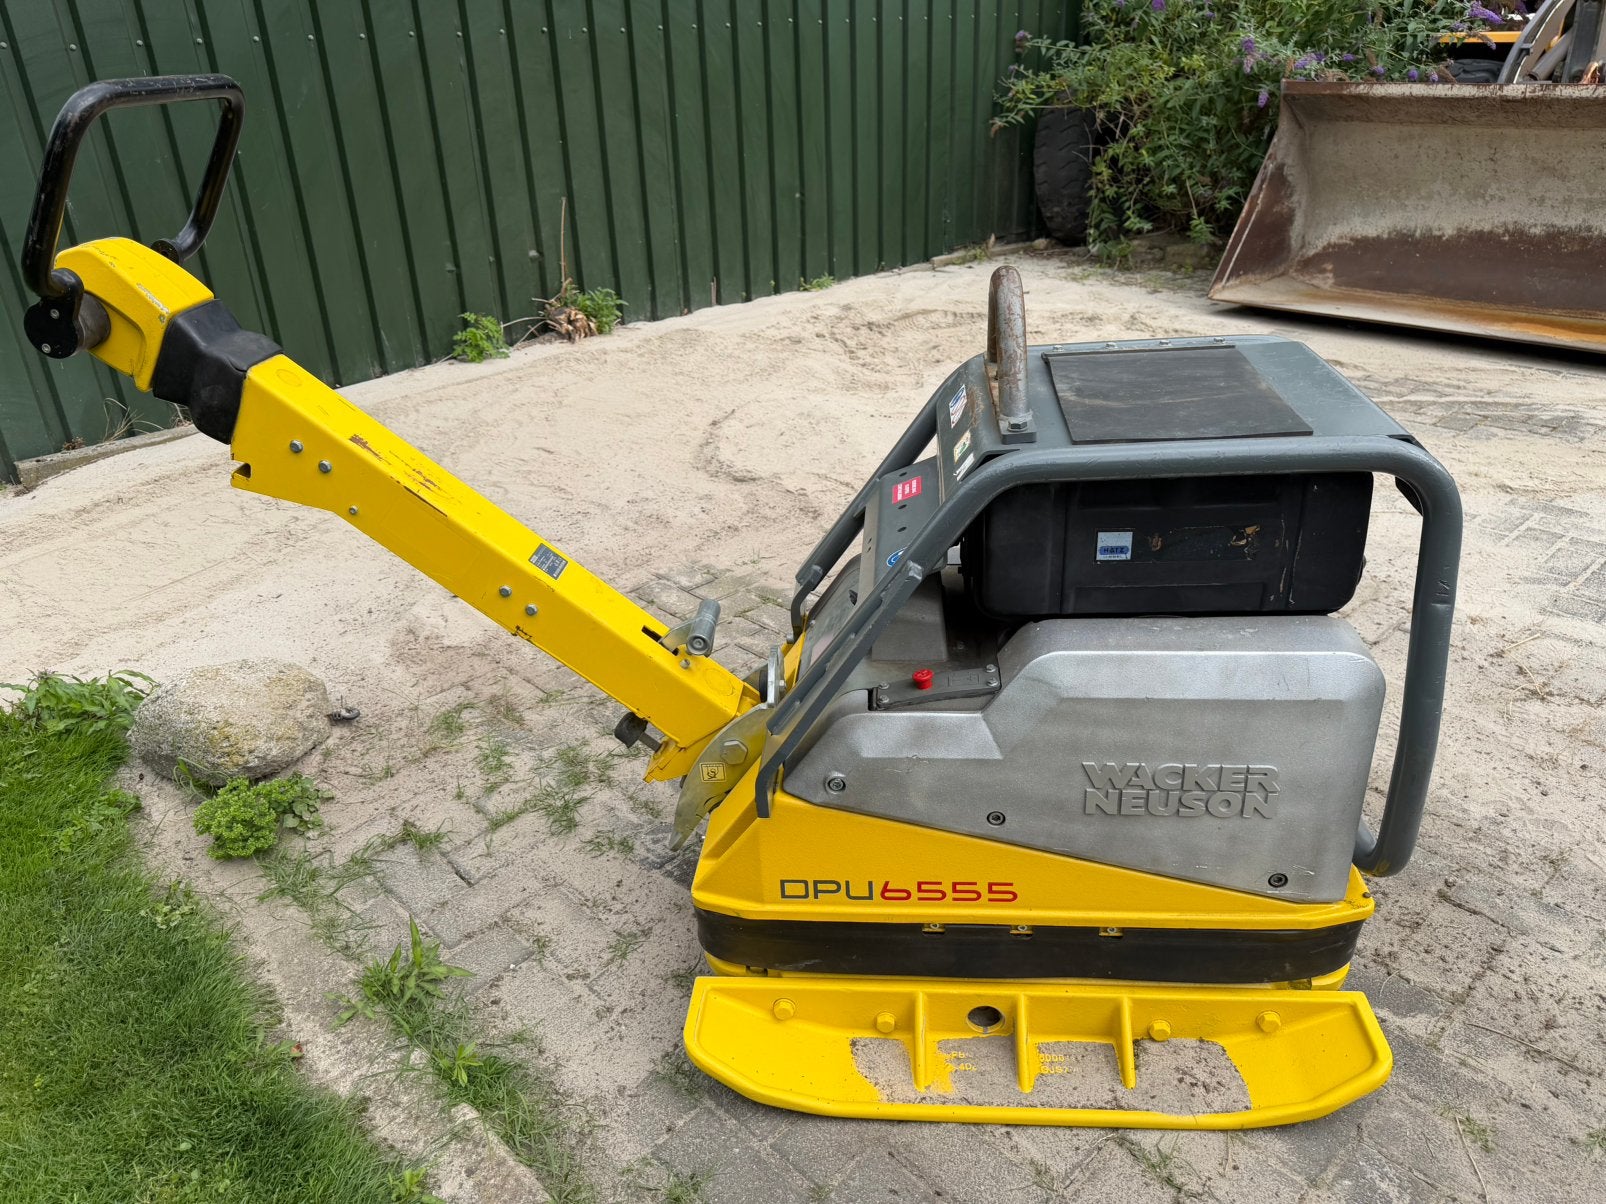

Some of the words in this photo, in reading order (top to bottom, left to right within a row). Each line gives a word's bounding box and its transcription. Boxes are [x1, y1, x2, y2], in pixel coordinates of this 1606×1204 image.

[1082, 762, 1280, 792] WACKER
[1085, 788, 1279, 819] NEUSON
[780, 879, 1018, 903] DPU6555
